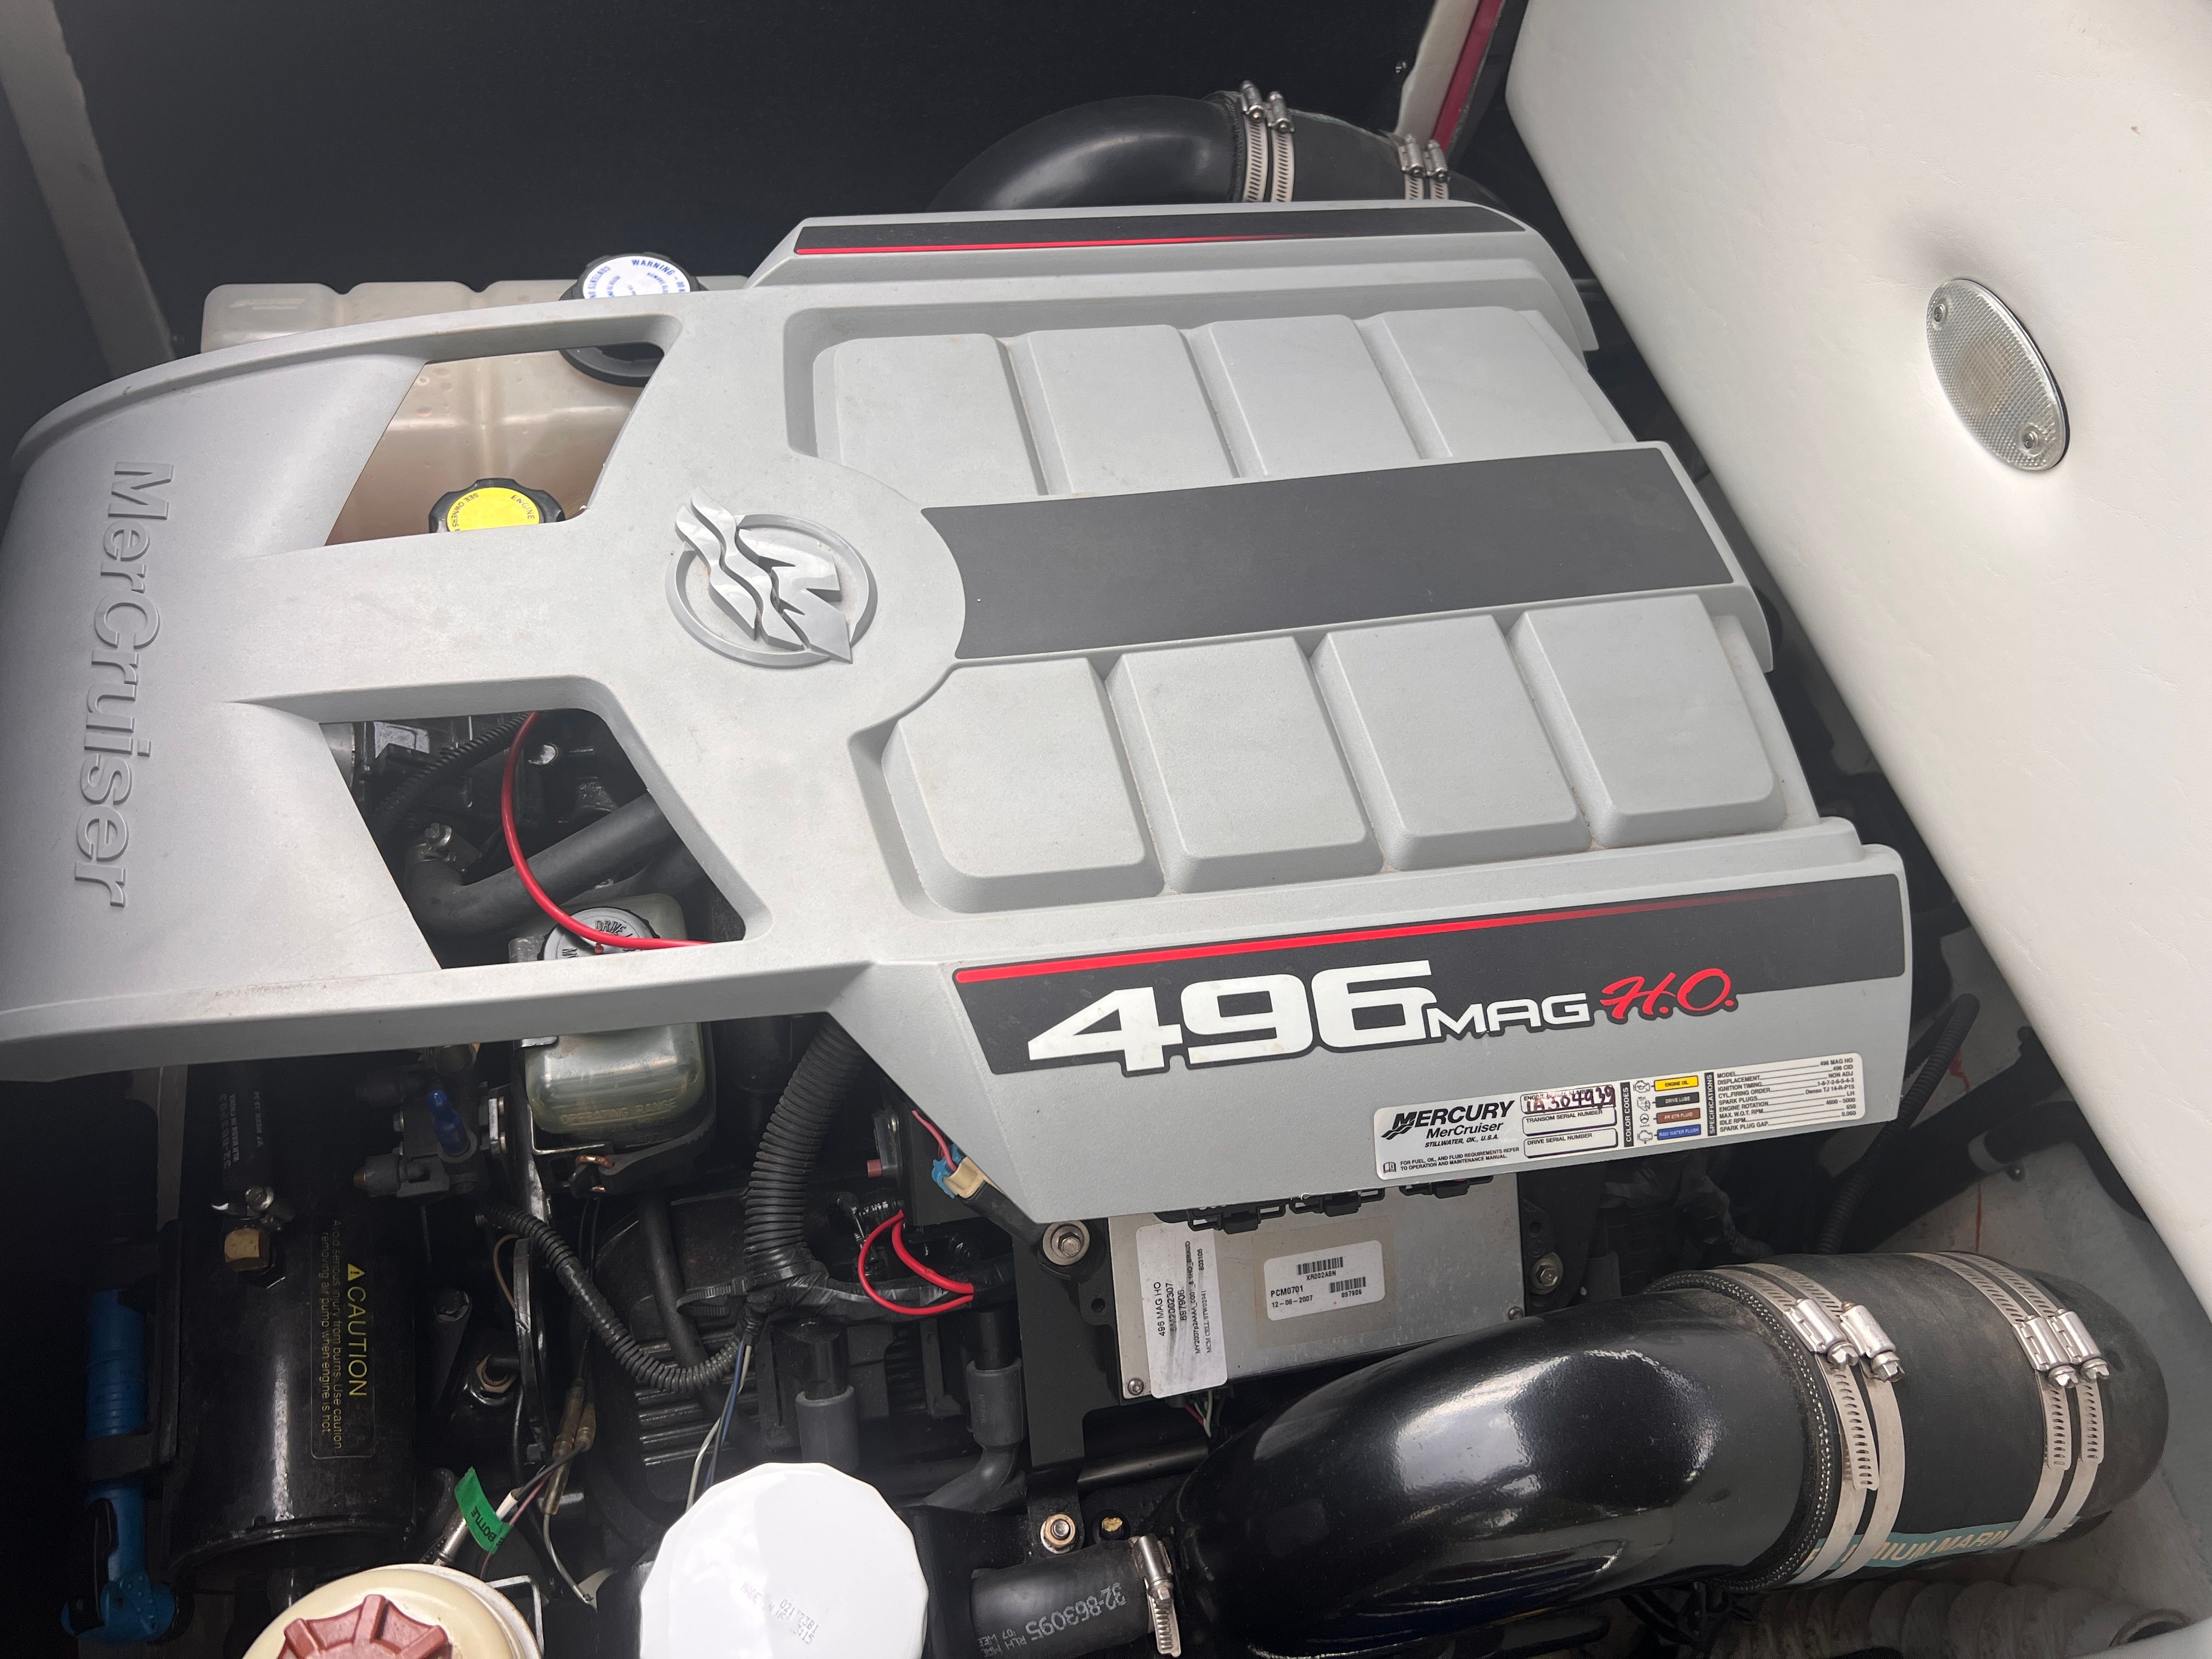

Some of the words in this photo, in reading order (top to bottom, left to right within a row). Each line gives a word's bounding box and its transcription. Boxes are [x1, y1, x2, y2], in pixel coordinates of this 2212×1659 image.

[631, 259, 676, 276] WARNING
[464, 493, 479, 502] SEE
[511, 495, 535, 520] ENGINE
[452, 502, 465, 527] OWNERS
[75, 462, 174, 907] MerCruiser
[1028, 960, 1437, 1071] 496
[1426, 993, 1590, 1038] MAG
[1600, 968, 1734, 1019] H.O.
[1718, 1075, 1760, 1085] DISPLACEMENT
[1718, 1084, 1742, 1092] IGNITION
[560, 1107, 629, 1125] OPERATING
[635, 1097, 676, 1115] RANGE
[1622, 1087, 1631, 1117] CODES
[1706, 1074, 1714, 1135] SPECIFICATIONS
[1741, 1101, 1769, 1109] ROTATION
[1392, 1100, 1515, 1130] MERCURY
[1578, 1109, 1602, 1118] NUMBER
[1426, 1122, 1503, 1138] MerCruiser
[1567, 1133, 1592, 1141] NUMBER
[1623, 1118, 1632, 1142] COLOR
[1425, 1138, 1464, 1148] STILLWATER,
[1408, 1162, 1437, 1170] OPERATION
[1449, 1156, 1485, 1165] MAINTENANCE
[1464, 1149, 1503, 1159] REQUIREMENTS
[1154, 1282, 1161, 1296] HO
[1271, 1285, 1304, 1297] PCM0701
[319, 1297, 330, 1327] pump
[1155, 1299, 1164, 1320] MAG
[1272, 1295, 1313, 1308] 12-06-2007
[332, 1320, 342, 1344] from
[347, 1286, 368, 1396] CAUTION
[321, 1329, 330, 1358] when
[319, 1362, 330, 1398] engine
[332, 1384, 343, 1406] Use
[321, 1402, 331, 1411] is
[332, 1408, 343, 1449] caution
[471, 1505, 498, 1542] BOTTLE
[741, 1582, 761, 1603] MADE
[1025, 1582, 1126, 1640] 32-863095
[1005, 1635, 1028, 1650] RLH
